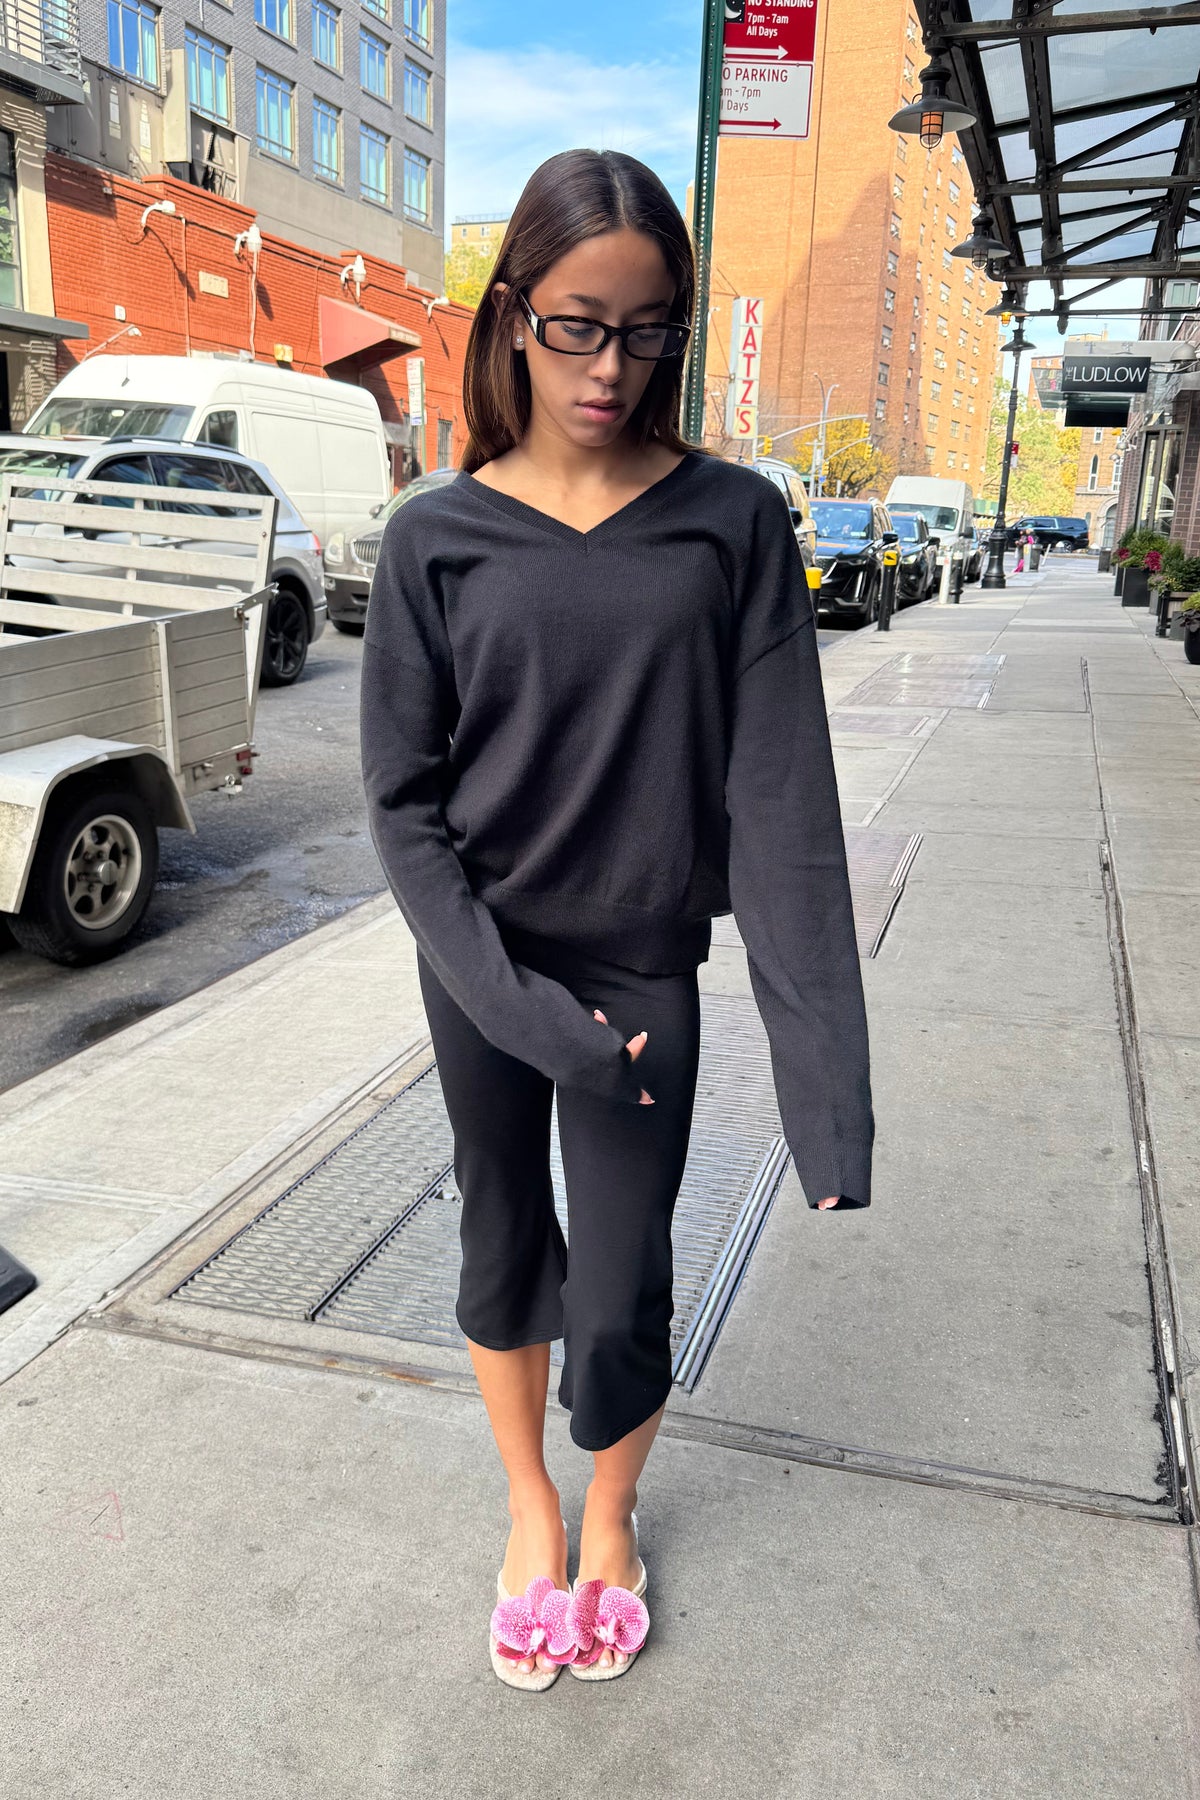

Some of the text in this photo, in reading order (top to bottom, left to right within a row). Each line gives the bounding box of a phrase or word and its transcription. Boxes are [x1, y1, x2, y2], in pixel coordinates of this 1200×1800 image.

[747, 12, 765, 25] 7pm
[771, 13, 789, 24] 7am
[746, 25, 778, 39] All Days
[722, 67, 788, 83] O PARKING
[741, 86, 761, 99] 7pm
[726, 99, 749, 114] Days
[736, 299, 760, 434] KATZ'S
[1072, 366, 1148, 383] LUDLOW
